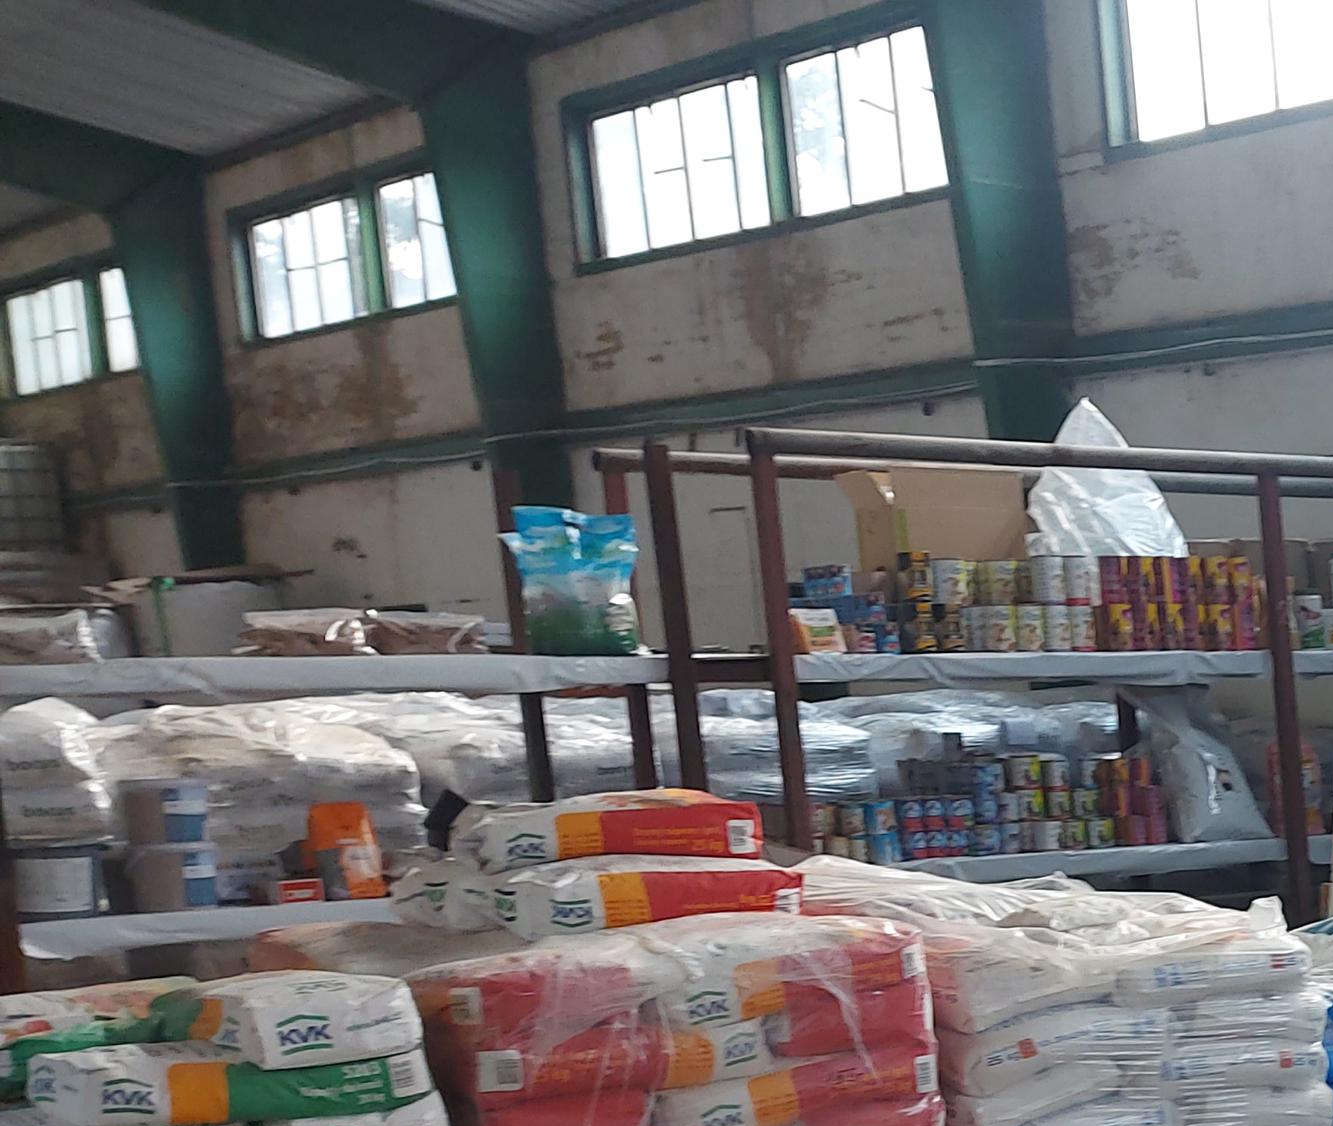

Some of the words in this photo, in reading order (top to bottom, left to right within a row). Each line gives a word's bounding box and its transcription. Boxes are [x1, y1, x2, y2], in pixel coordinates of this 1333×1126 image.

[689, 999, 729, 1018] KVK
[279, 1024, 332, 1046] KVK
[102, 1089, 156, 1106] KVK
